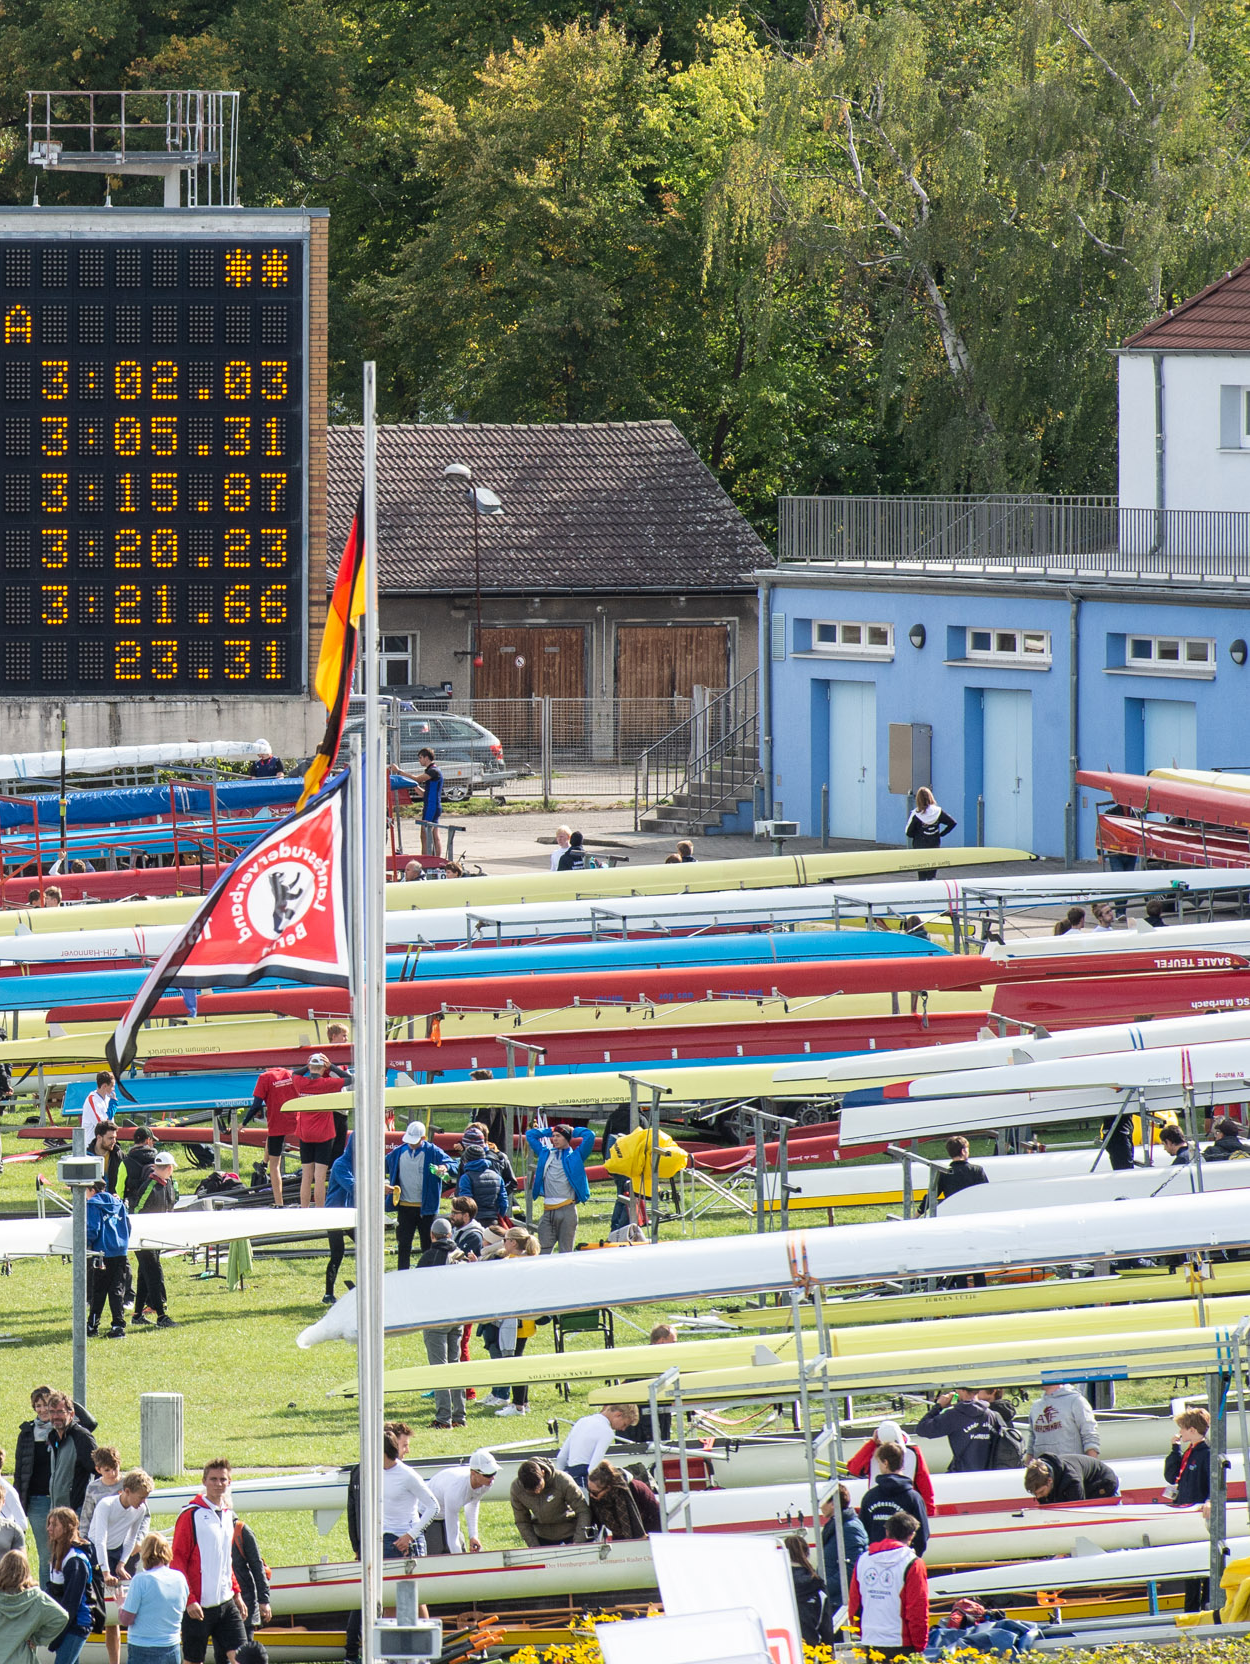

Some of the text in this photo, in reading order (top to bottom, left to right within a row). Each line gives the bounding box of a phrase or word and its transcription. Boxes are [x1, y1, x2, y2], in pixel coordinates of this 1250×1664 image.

[41, 360, 288, 400] 3:02.03
[41, 416, 282, 457] 3:05.31
[41, 472, 287, 513] 3:15.87
[41, 528, 288, 569] 3:20.23
[41, 584, 287, 625] 3:21.66
[114, 640, 282, 680] 23.31
[61, 948, 118, 957] ZfH-Hannover
[1154, 957, 1232, 968] SAALE TEUFEL
[1191, 998, 1234, 1009] Marbach
[148, 1047, 183, 1055] Osnabrück
